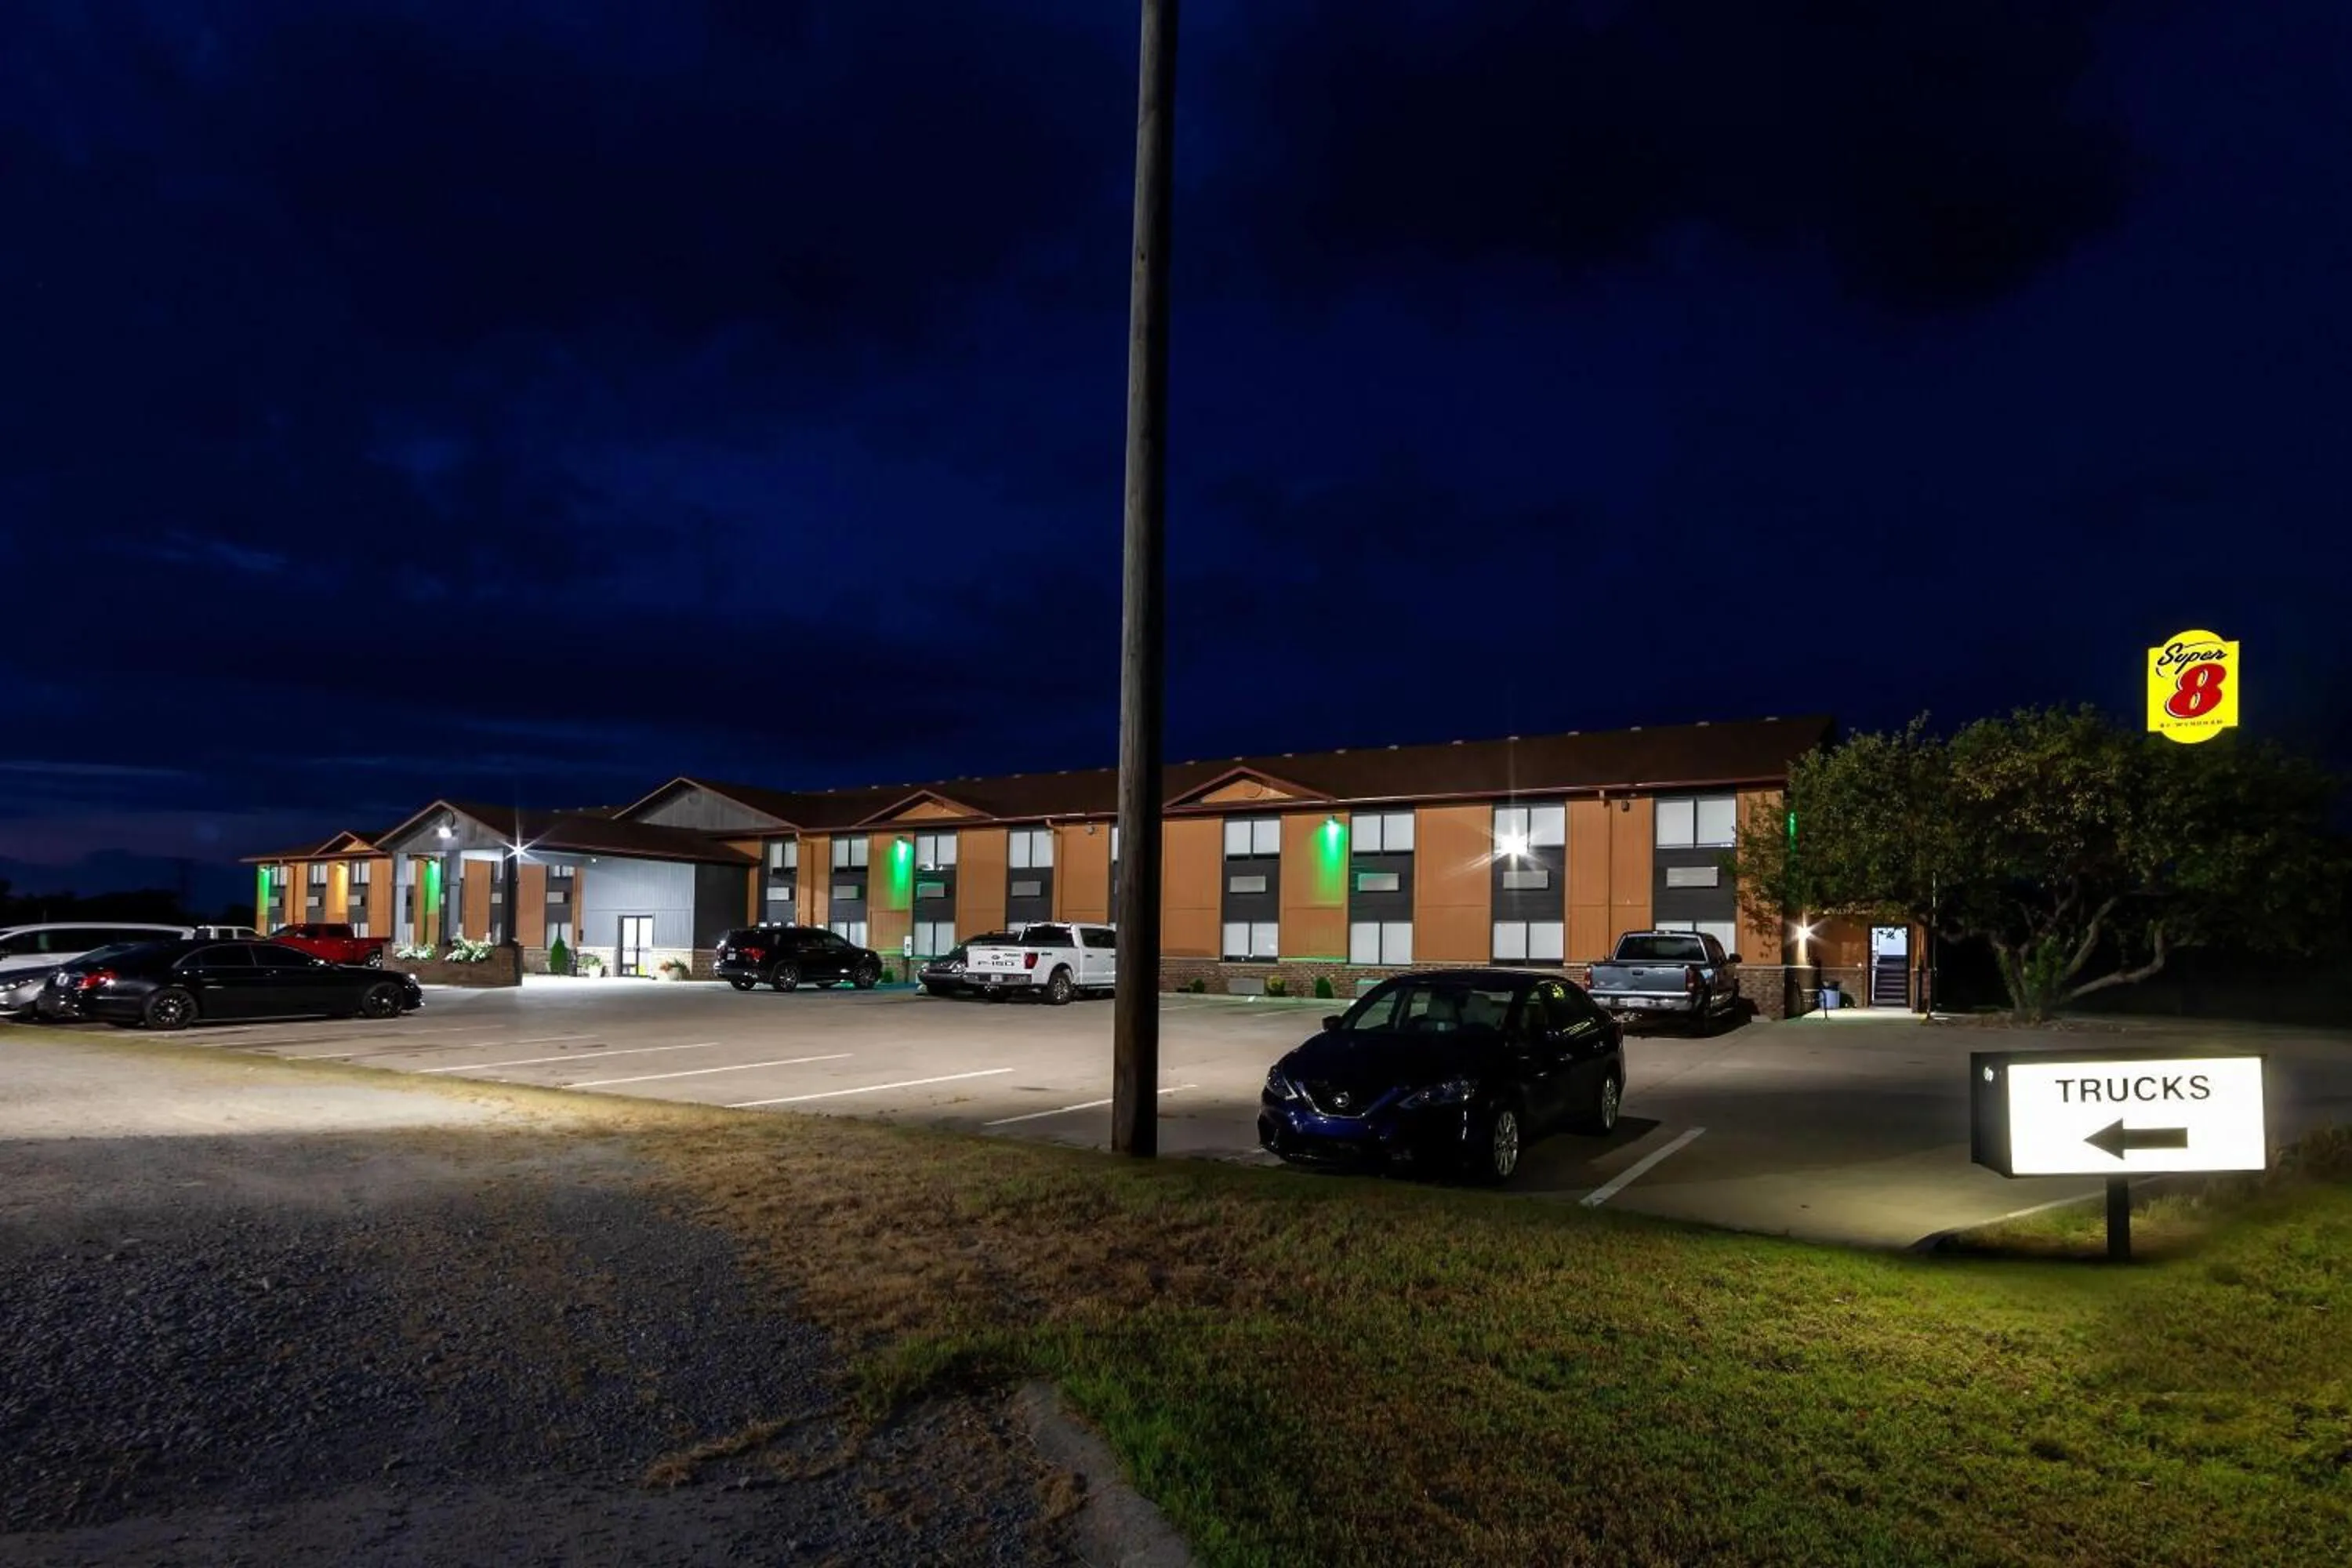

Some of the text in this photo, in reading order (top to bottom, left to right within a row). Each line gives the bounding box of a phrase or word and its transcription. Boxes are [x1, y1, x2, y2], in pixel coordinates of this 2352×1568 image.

[2156, 641, 2227, 675] Super
[2164, 662, 2227, 719] 8
[2056, 1075, 2211, 1103] TRUCKS
